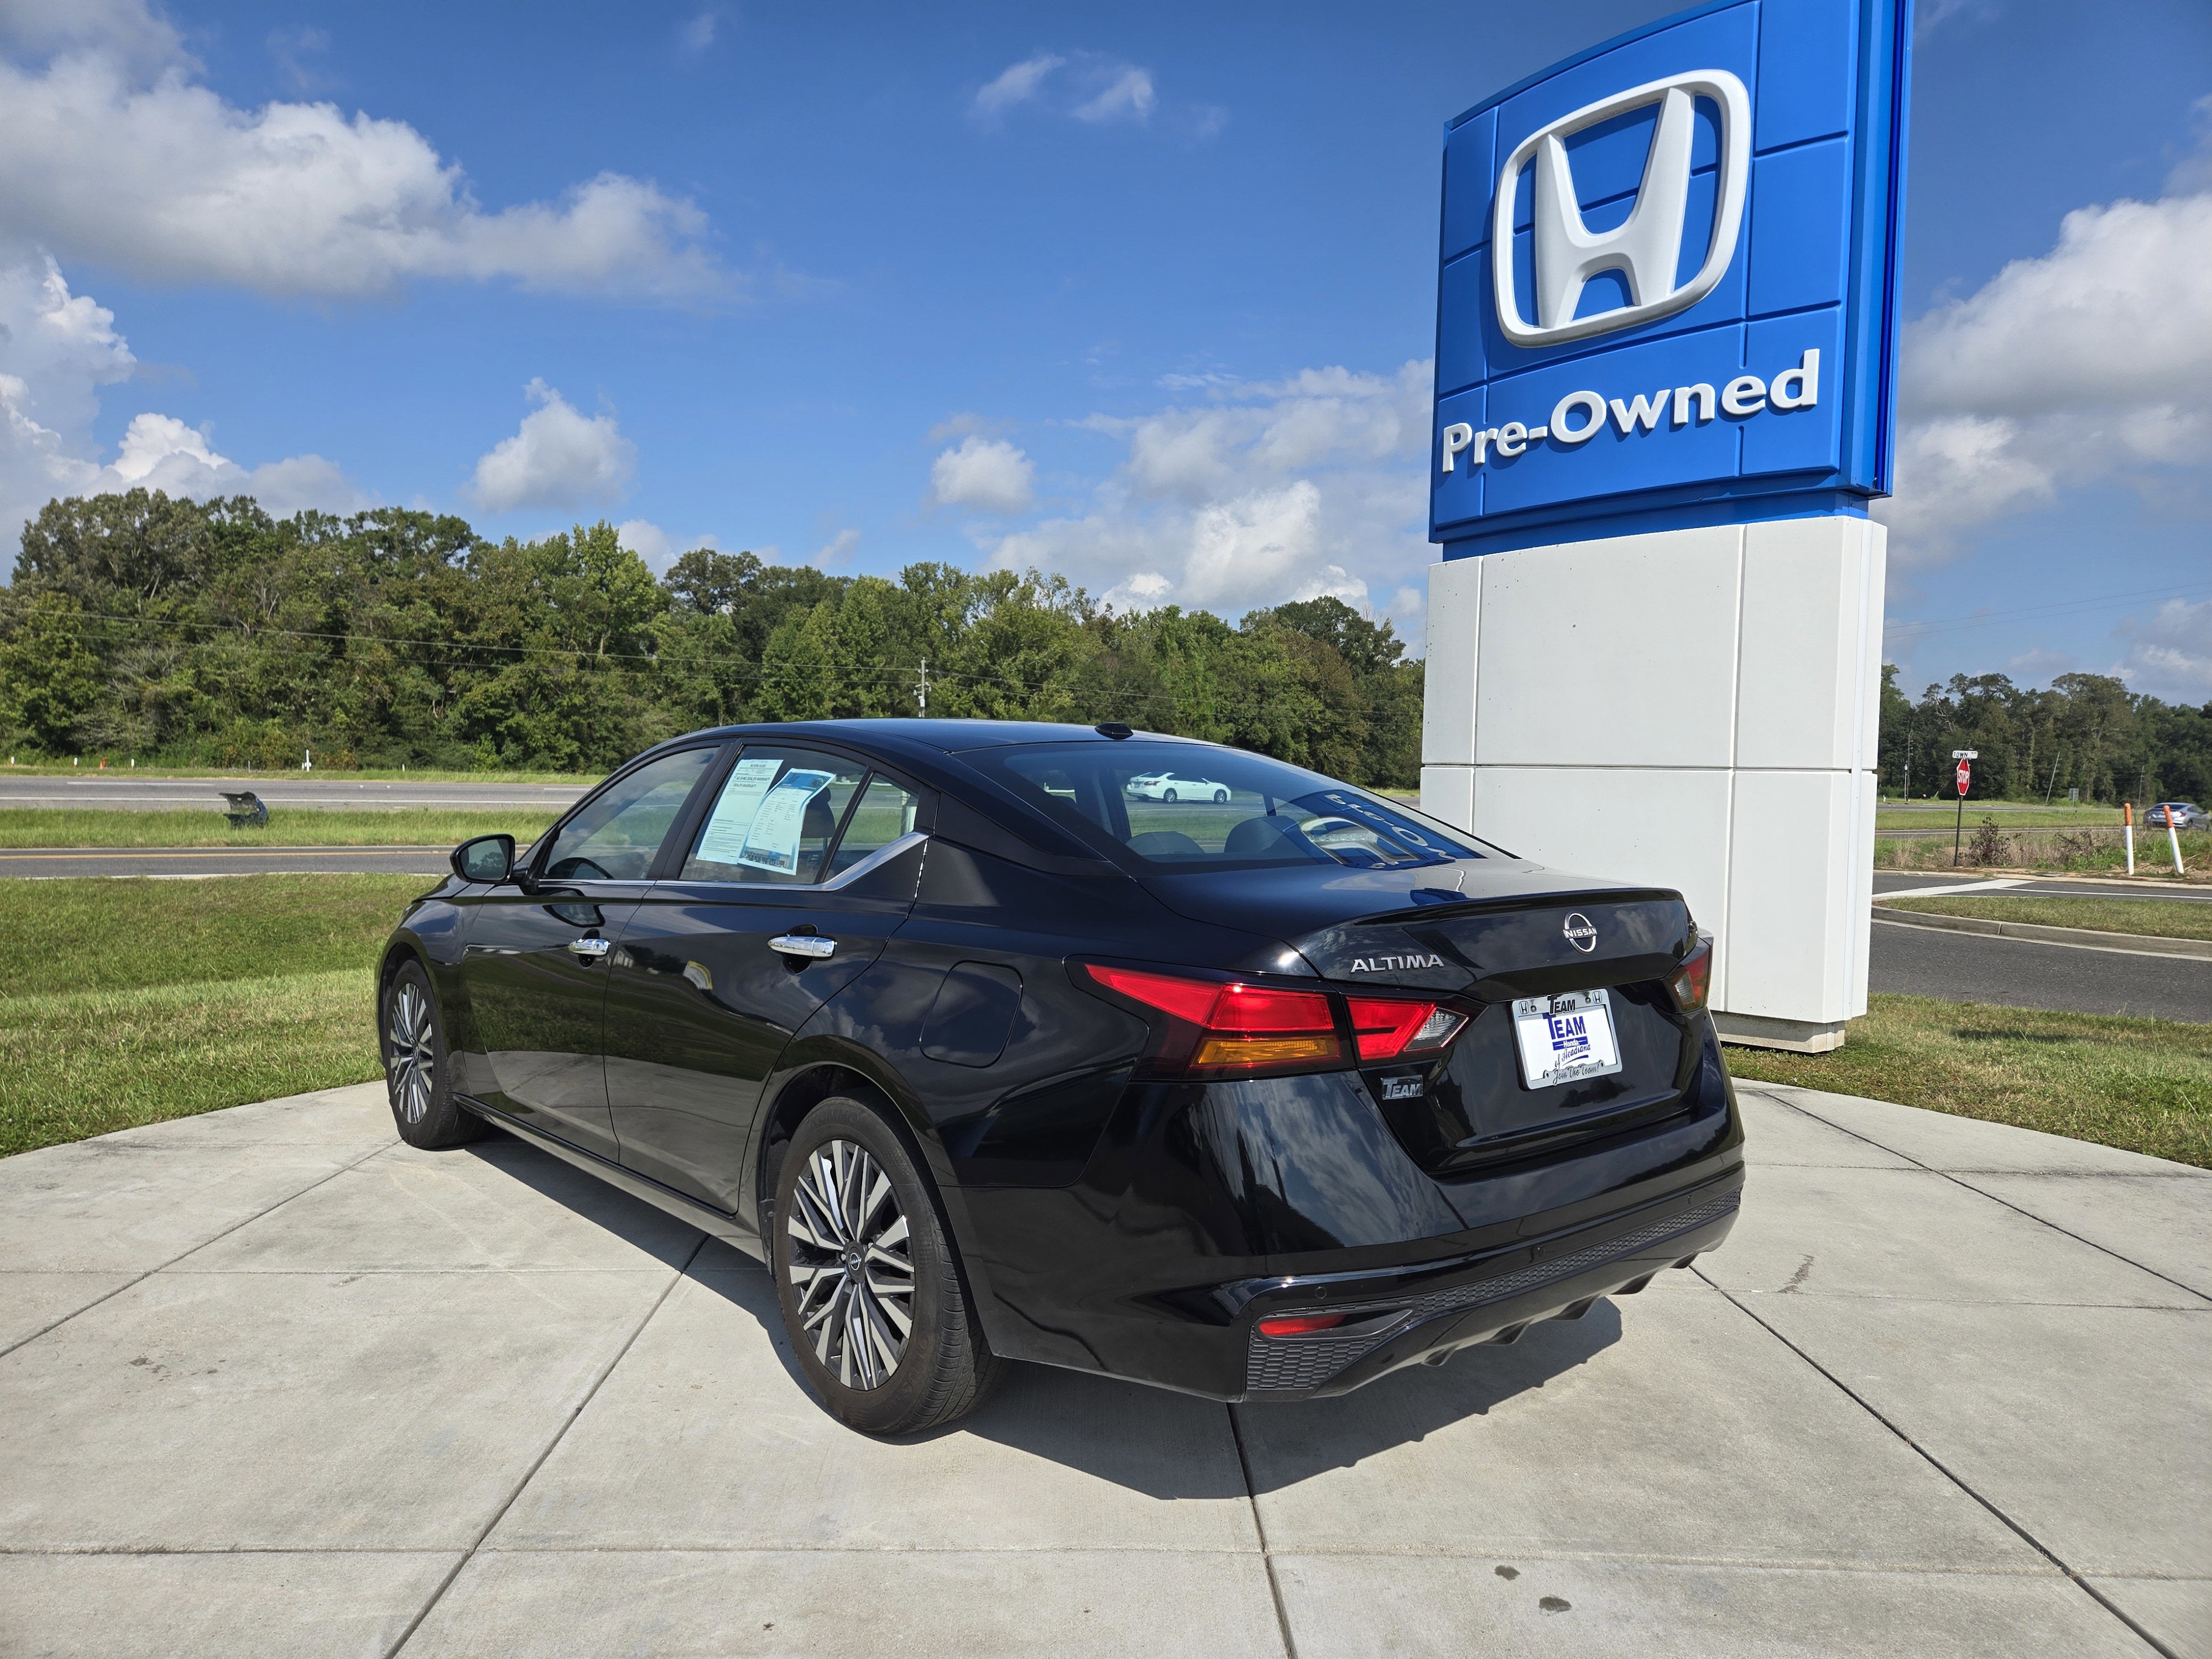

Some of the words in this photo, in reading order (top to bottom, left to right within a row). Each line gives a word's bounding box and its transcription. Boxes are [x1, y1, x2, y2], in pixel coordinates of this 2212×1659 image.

[1442, 348, 1820, 473] Pre-Owned
[1958, 769, 1969, 784] STOP
[1564, 927, 1598, 937] NISSAN
[1350, 954, 1444, 973] ALTIMA
[1563, 1039, 1579, 1048] Honda
[1561, 1044, 1591, 1062] Acadiana
